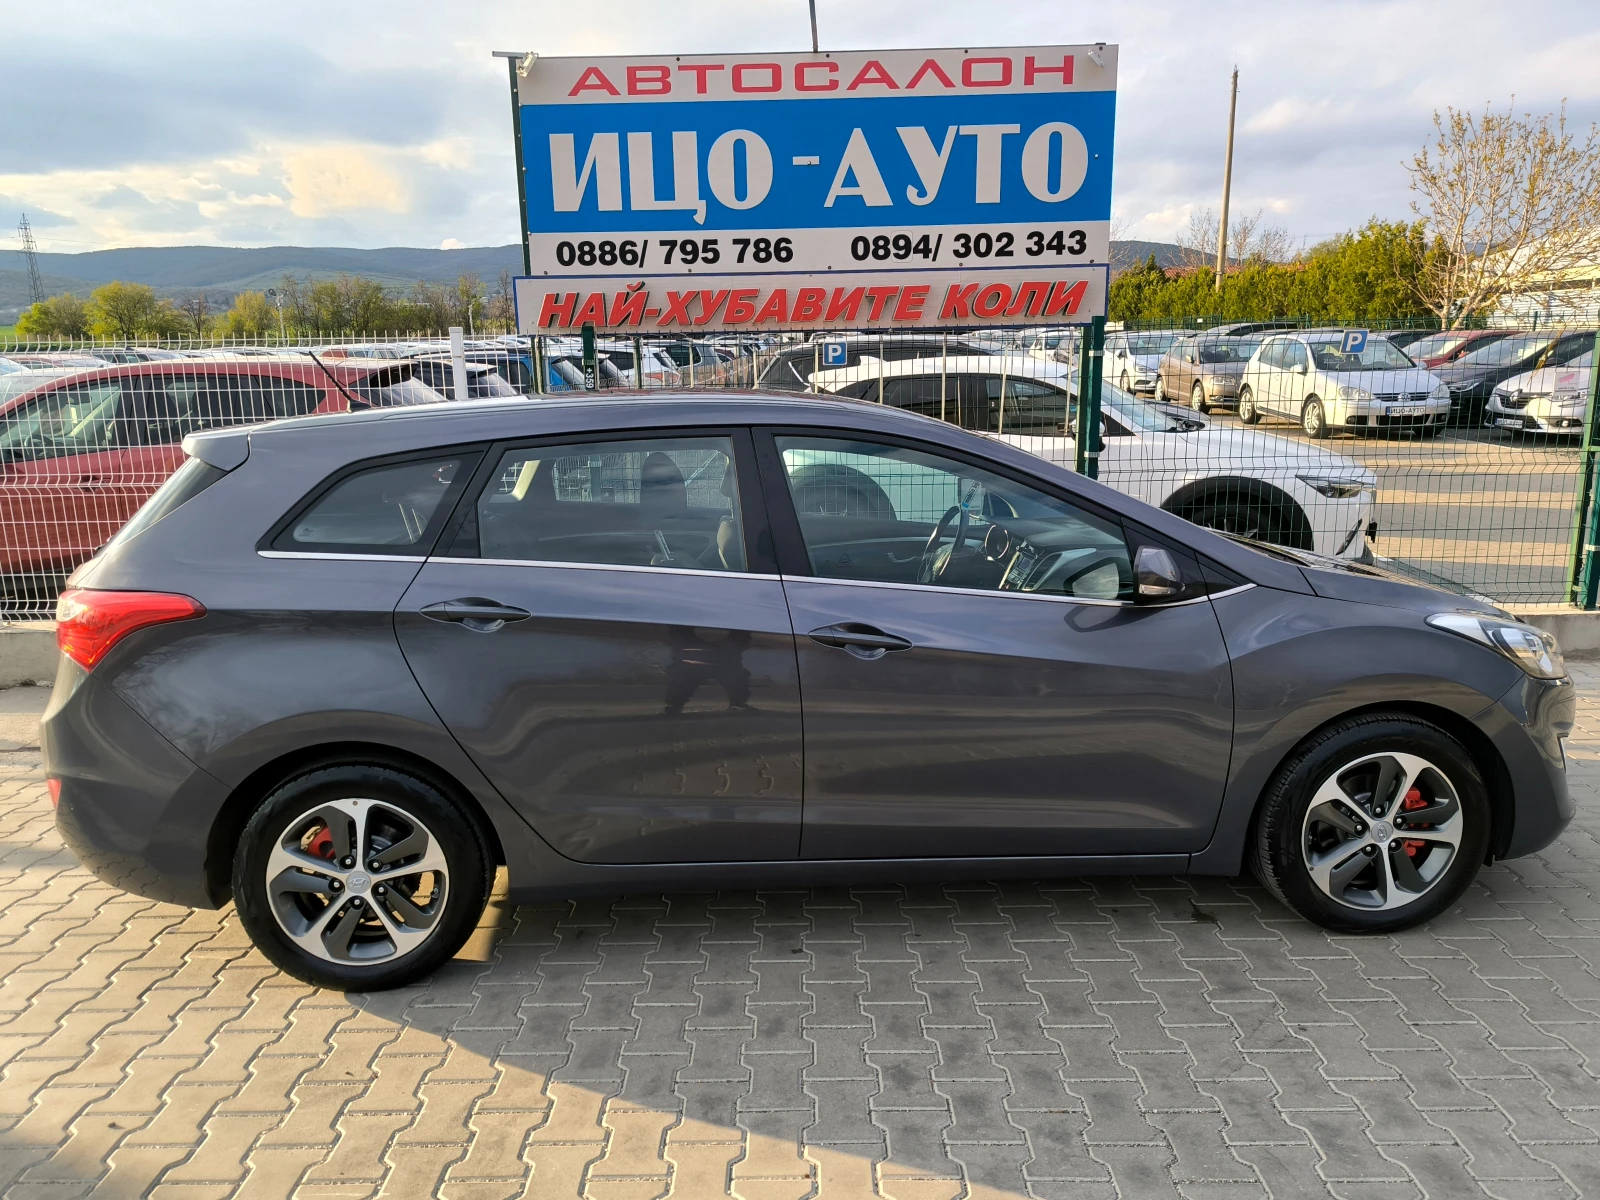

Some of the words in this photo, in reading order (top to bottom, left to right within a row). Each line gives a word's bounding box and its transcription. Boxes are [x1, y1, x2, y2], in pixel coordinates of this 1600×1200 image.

[569, 55, 1075, 97] АВТОСАЛОН
[556, 239, 649, 268] 0886/
[659, 238, 720, 265] 795
[732, 237, 794, 264] 786
[850, 233, 943, 262] 0894/
[952, 231, 1015, 259] 302
[1025, 229, 1087, 257] 343
[537, 280, 933, 328] НАЙ-ХУБАВИТЕ
[940, 280, 1090, 321] КОЛИ
[828, 344, 842, 363] P
[1345, 333, 1363, 352] P
[585, 367, 595, 389] +359
